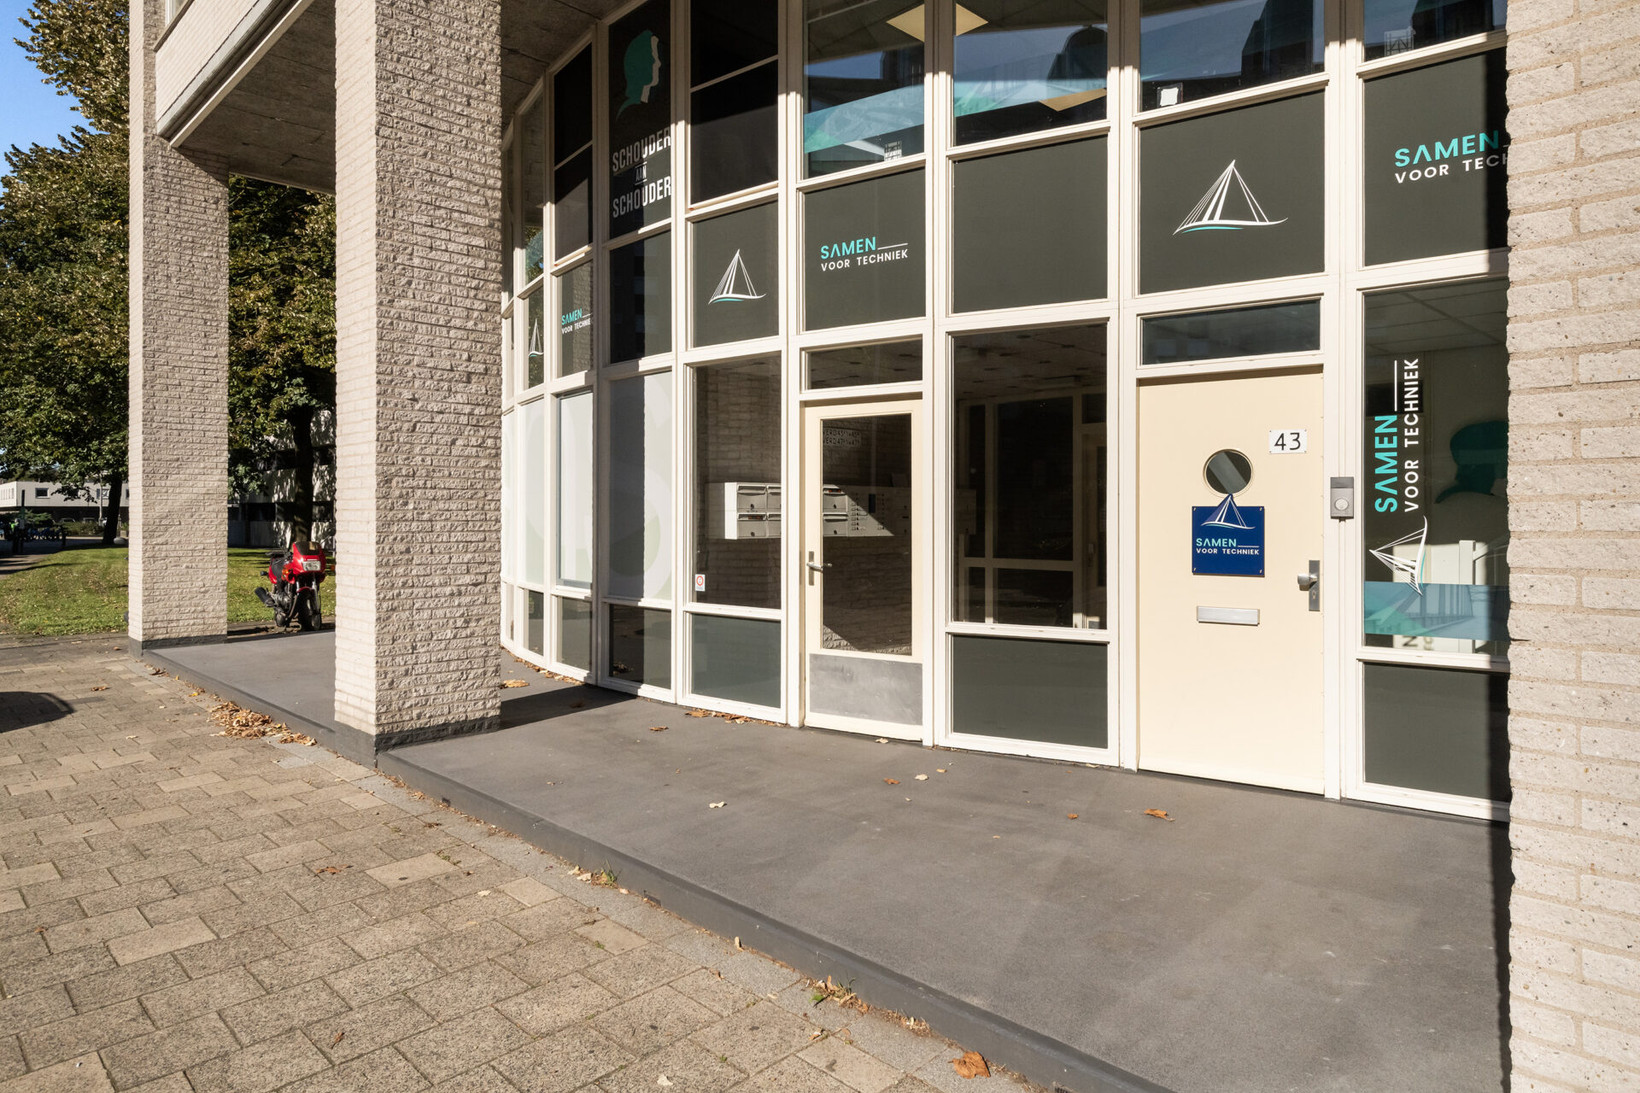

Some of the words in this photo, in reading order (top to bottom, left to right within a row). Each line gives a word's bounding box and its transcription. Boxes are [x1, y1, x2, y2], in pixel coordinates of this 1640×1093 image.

[612, 126, 671, 172] SCHOUDER
[1394, 130, 1499, 168] SAMEN
[1395, 164, 1449, 184] VOOR
[612, 175, 671, 218] SCHOUDER
[820, 236, 876, 260] SAMEN
[820, 259, 850, 272] VOOR
[856, 248, 908, 266] TECHNIEK
[561, 307, 583, 326] SAMEN
[1404, 358, 1419, 448] TECHNIEK
[1274, 432, 1301, 451] 43
[1374, 415, 1398, 513] SAMEN
[1404, 460, 1419, 513] VOOR
[1196, 537, 1237, 548] SAMEN
[1222, 548, 1260, 556] TECHNIEK
